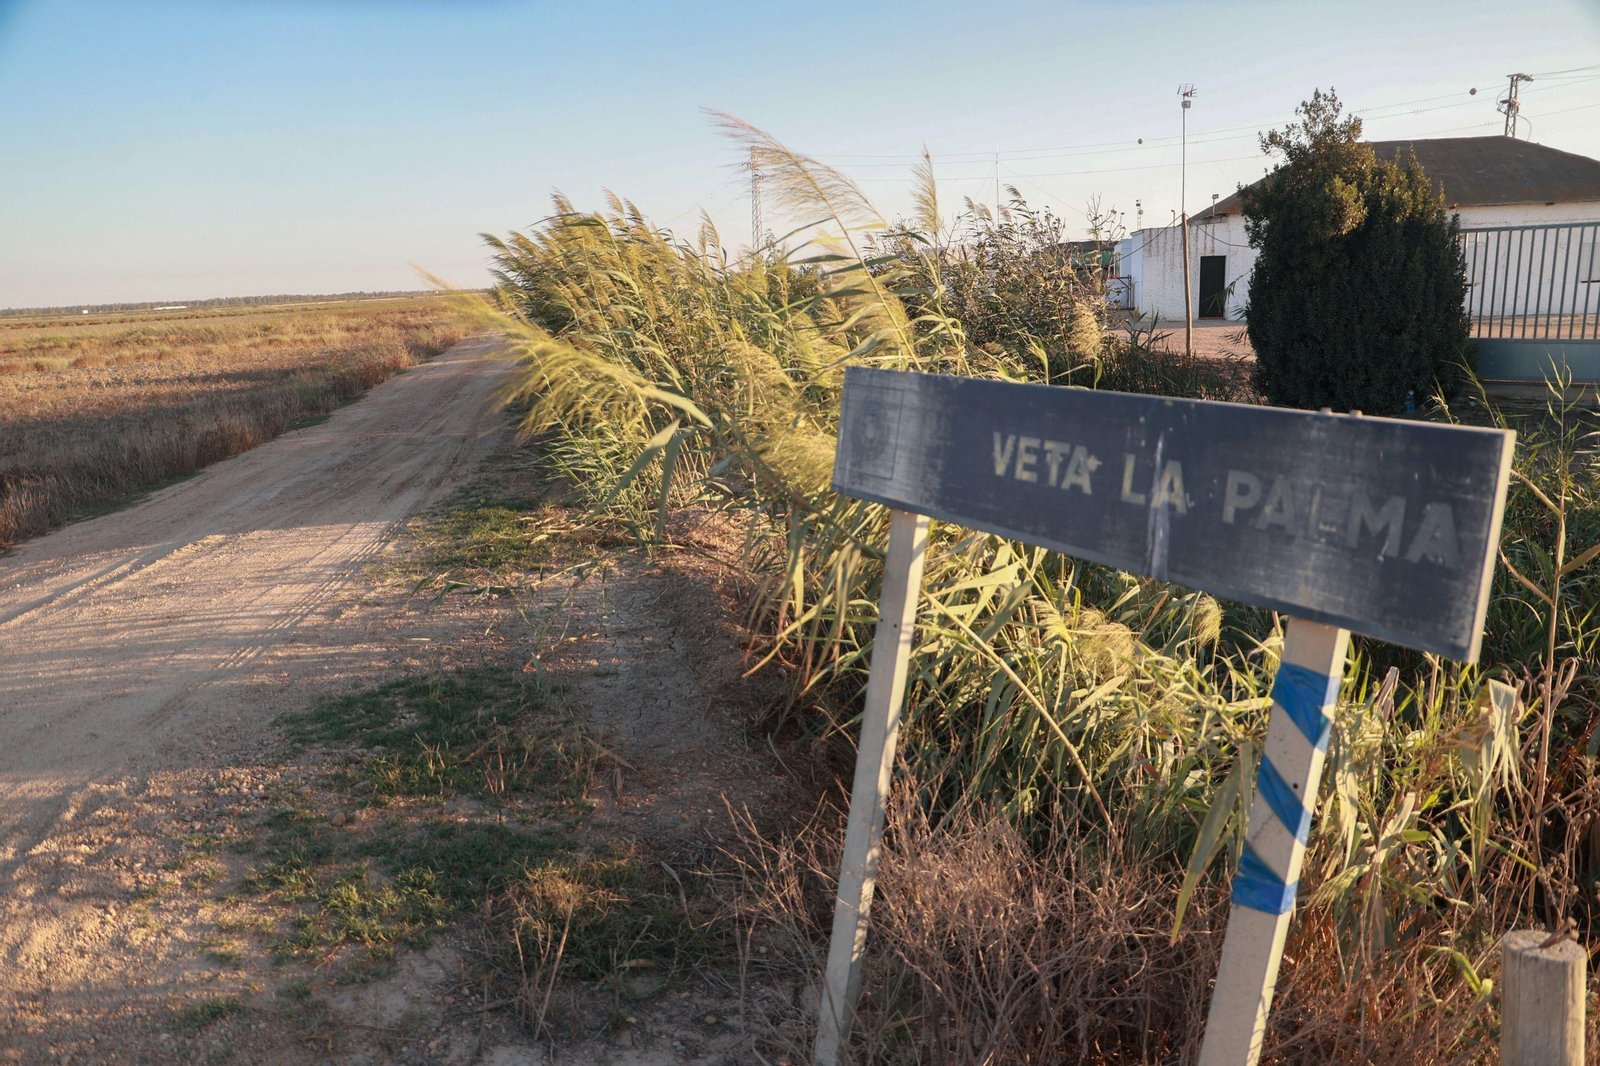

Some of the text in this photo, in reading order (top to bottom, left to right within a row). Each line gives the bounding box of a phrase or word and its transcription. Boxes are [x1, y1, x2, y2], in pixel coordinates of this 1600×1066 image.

[992, 431, 1461, 566] VETA LA PALMA
